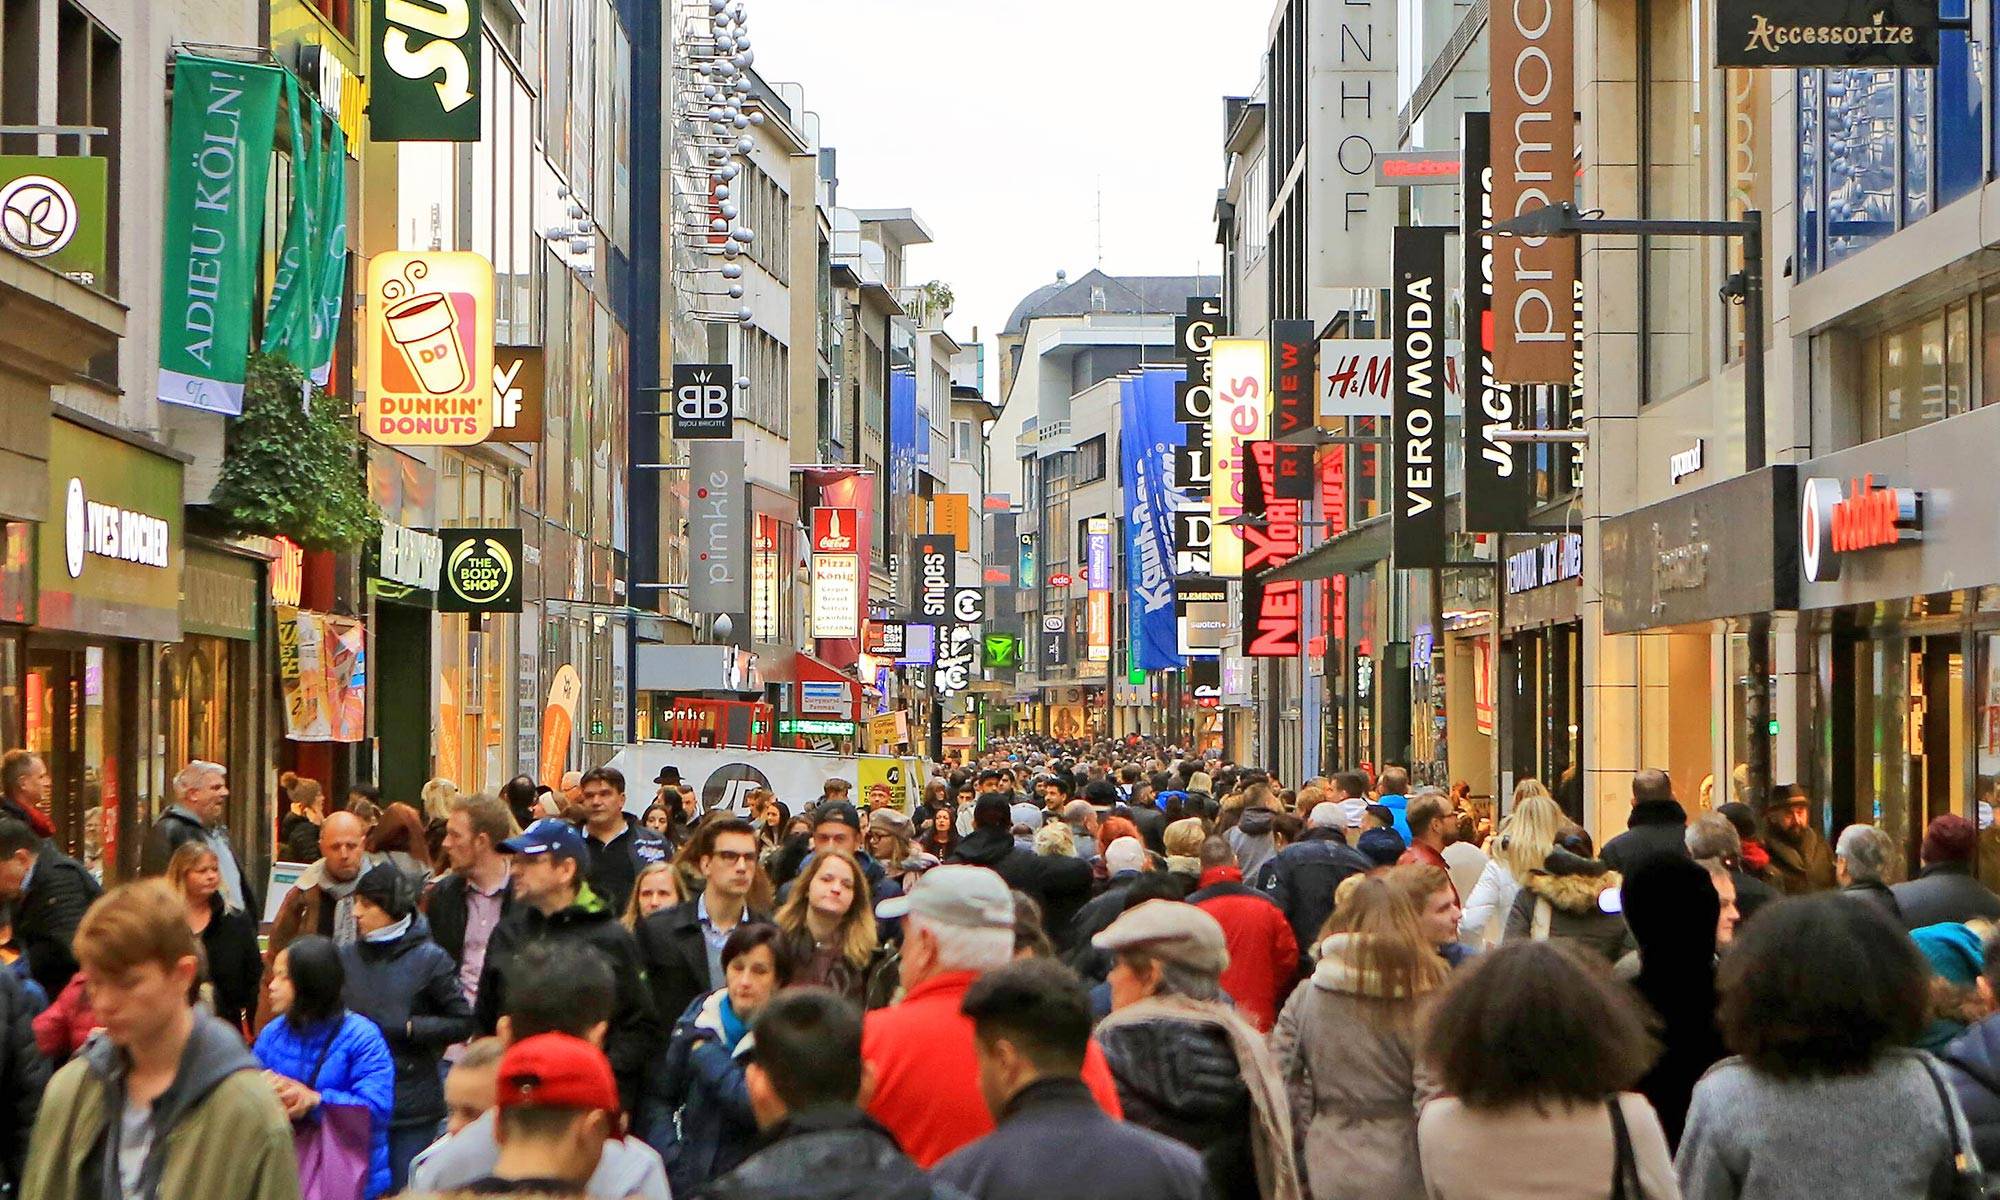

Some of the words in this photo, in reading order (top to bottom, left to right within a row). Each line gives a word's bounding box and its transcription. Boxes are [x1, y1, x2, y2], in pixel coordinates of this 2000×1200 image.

[1744, 15, 1914, 53] Accessorize
[192, 71, 246, 214] KÖLN!
[184, 224, 226, 369] ADIEU
[1406, 276, 1433, 398] MODA
[419, 344, 448, 364] DD
[1328, 354, 1391, 401] H&M
[380, 398, 483, 415] DUNKIN'
[380, 417, 477, 434] DONUTS
[1406, 408, 1433, 517] VERO
[697, 469, 734, 584] pimkie
[461, 568, 501, 580] BODY
[469, 558, 491, 567] THE
[820, 558, 852, 567] Pizza
[463, 580, 499, 591] SHOP
[924, 553, 949, 616] snipes
[1178, 592, 1224, 600] ELEMENTS
